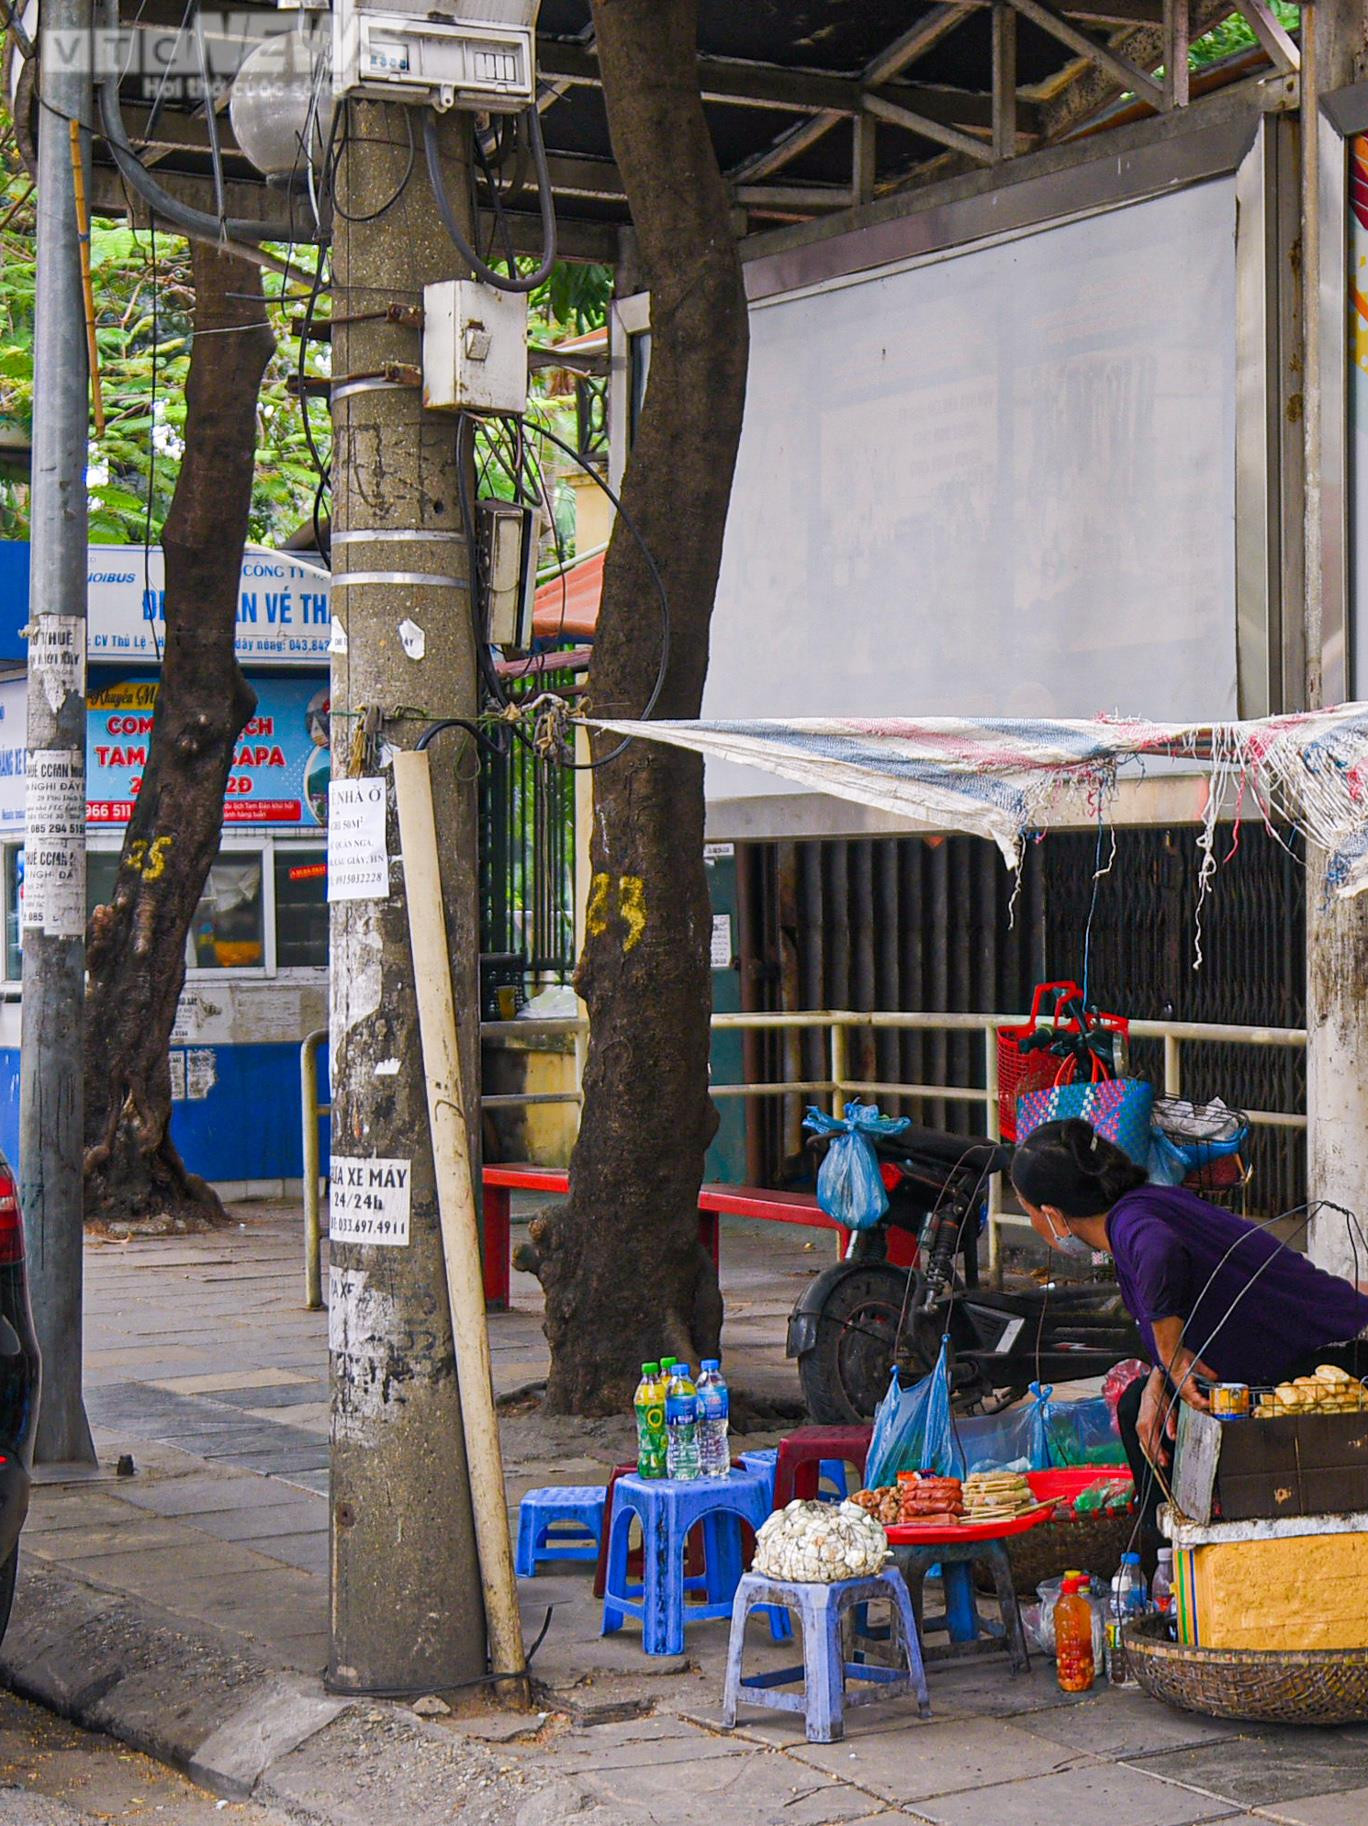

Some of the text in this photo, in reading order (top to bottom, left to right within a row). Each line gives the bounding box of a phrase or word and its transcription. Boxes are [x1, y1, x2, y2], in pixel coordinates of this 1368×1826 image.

[242, 560, 286, 578] CÔNG
[265, 585, 294, 624] VÉ
[299, 592, 333, 625] TH
[94, 745, 147, 768] TAM
[347, 1166, 364, 1187] XE
[368, 1164, 408, 1188] MÁY
[334, 1191, 384, 1211] 24/24h
